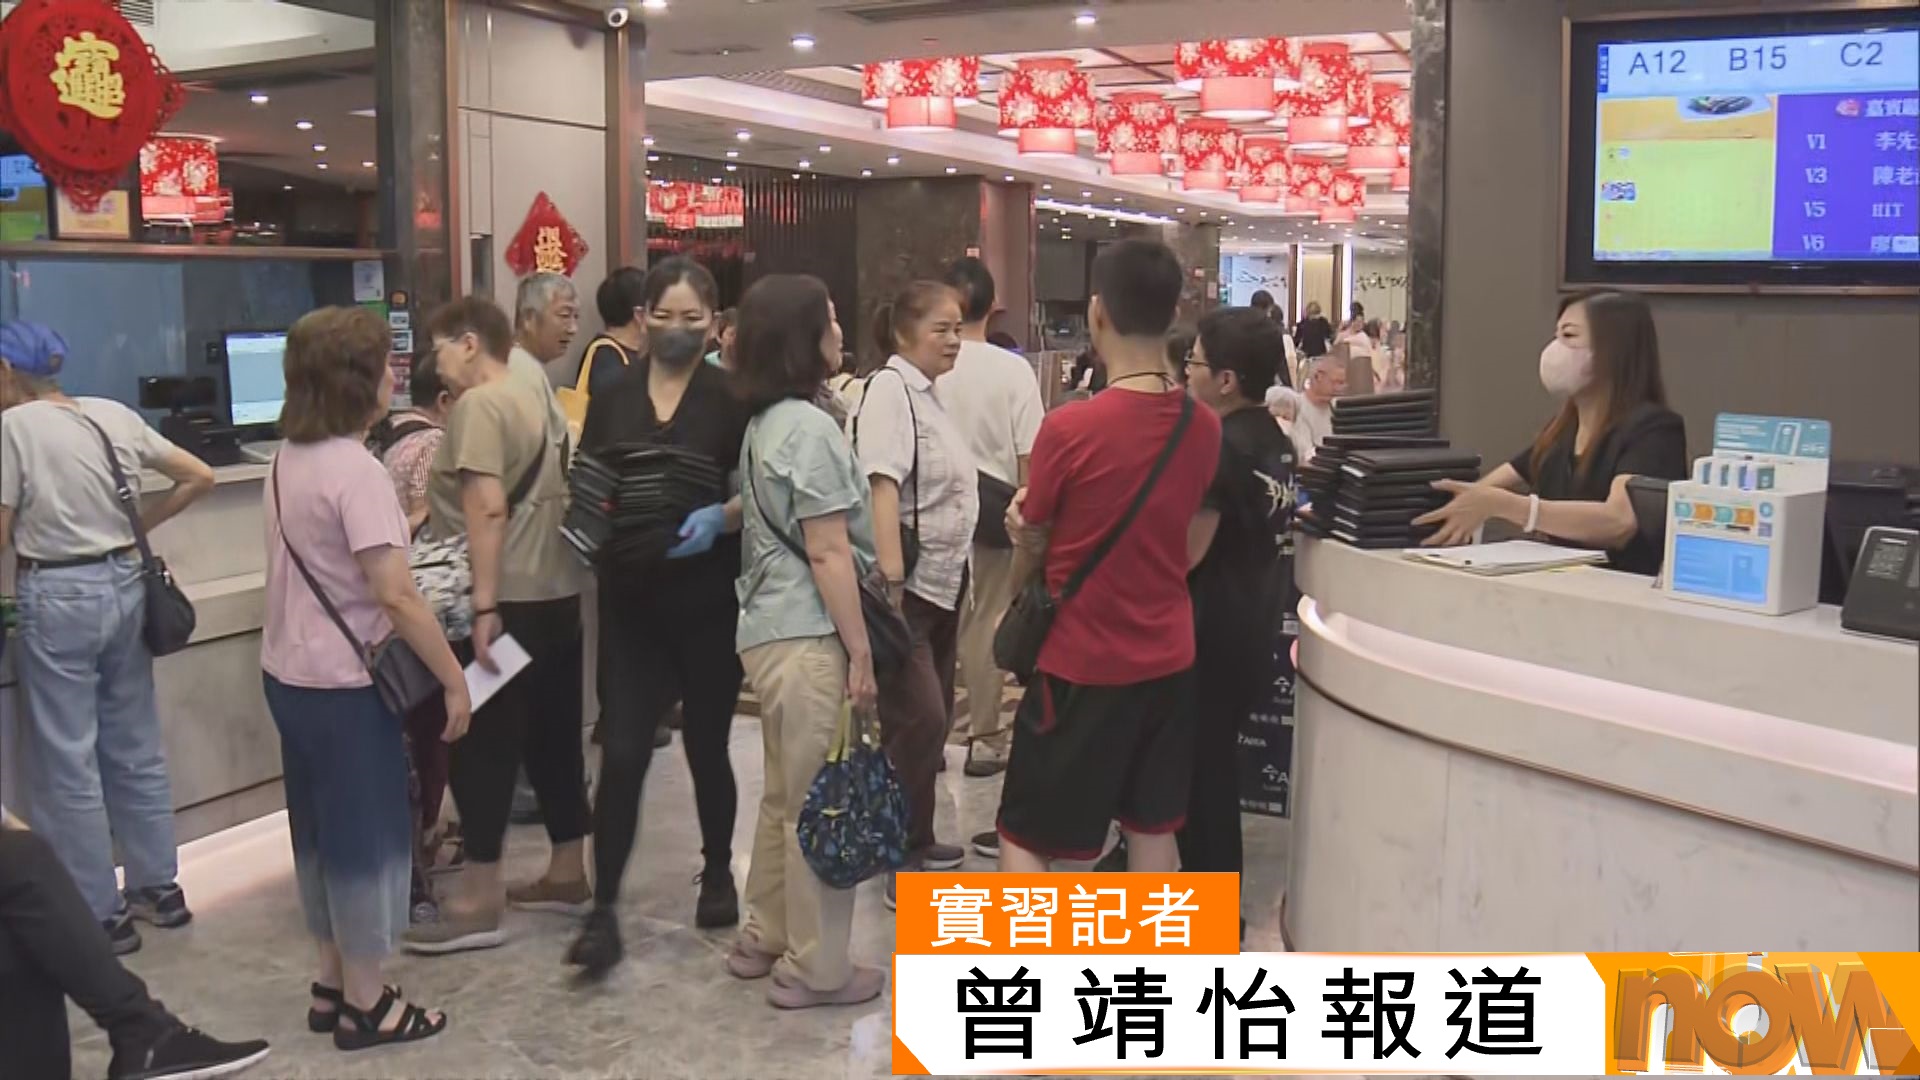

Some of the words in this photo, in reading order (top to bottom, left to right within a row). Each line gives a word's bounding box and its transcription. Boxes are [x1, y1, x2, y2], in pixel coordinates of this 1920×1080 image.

[1629, 49, 1687, 75] A12
[1728, 45, 1787, 72] B15
[1840, 41, 1883, 67] C2
[1807, 133, 1826, 150] V1
[1805, 167, 1828, 184] V3
[1872, 165, 1919, 186] 陳老
[1803, 201, 1827, 218] V5
[1802, 234, 1825, 251] V6
